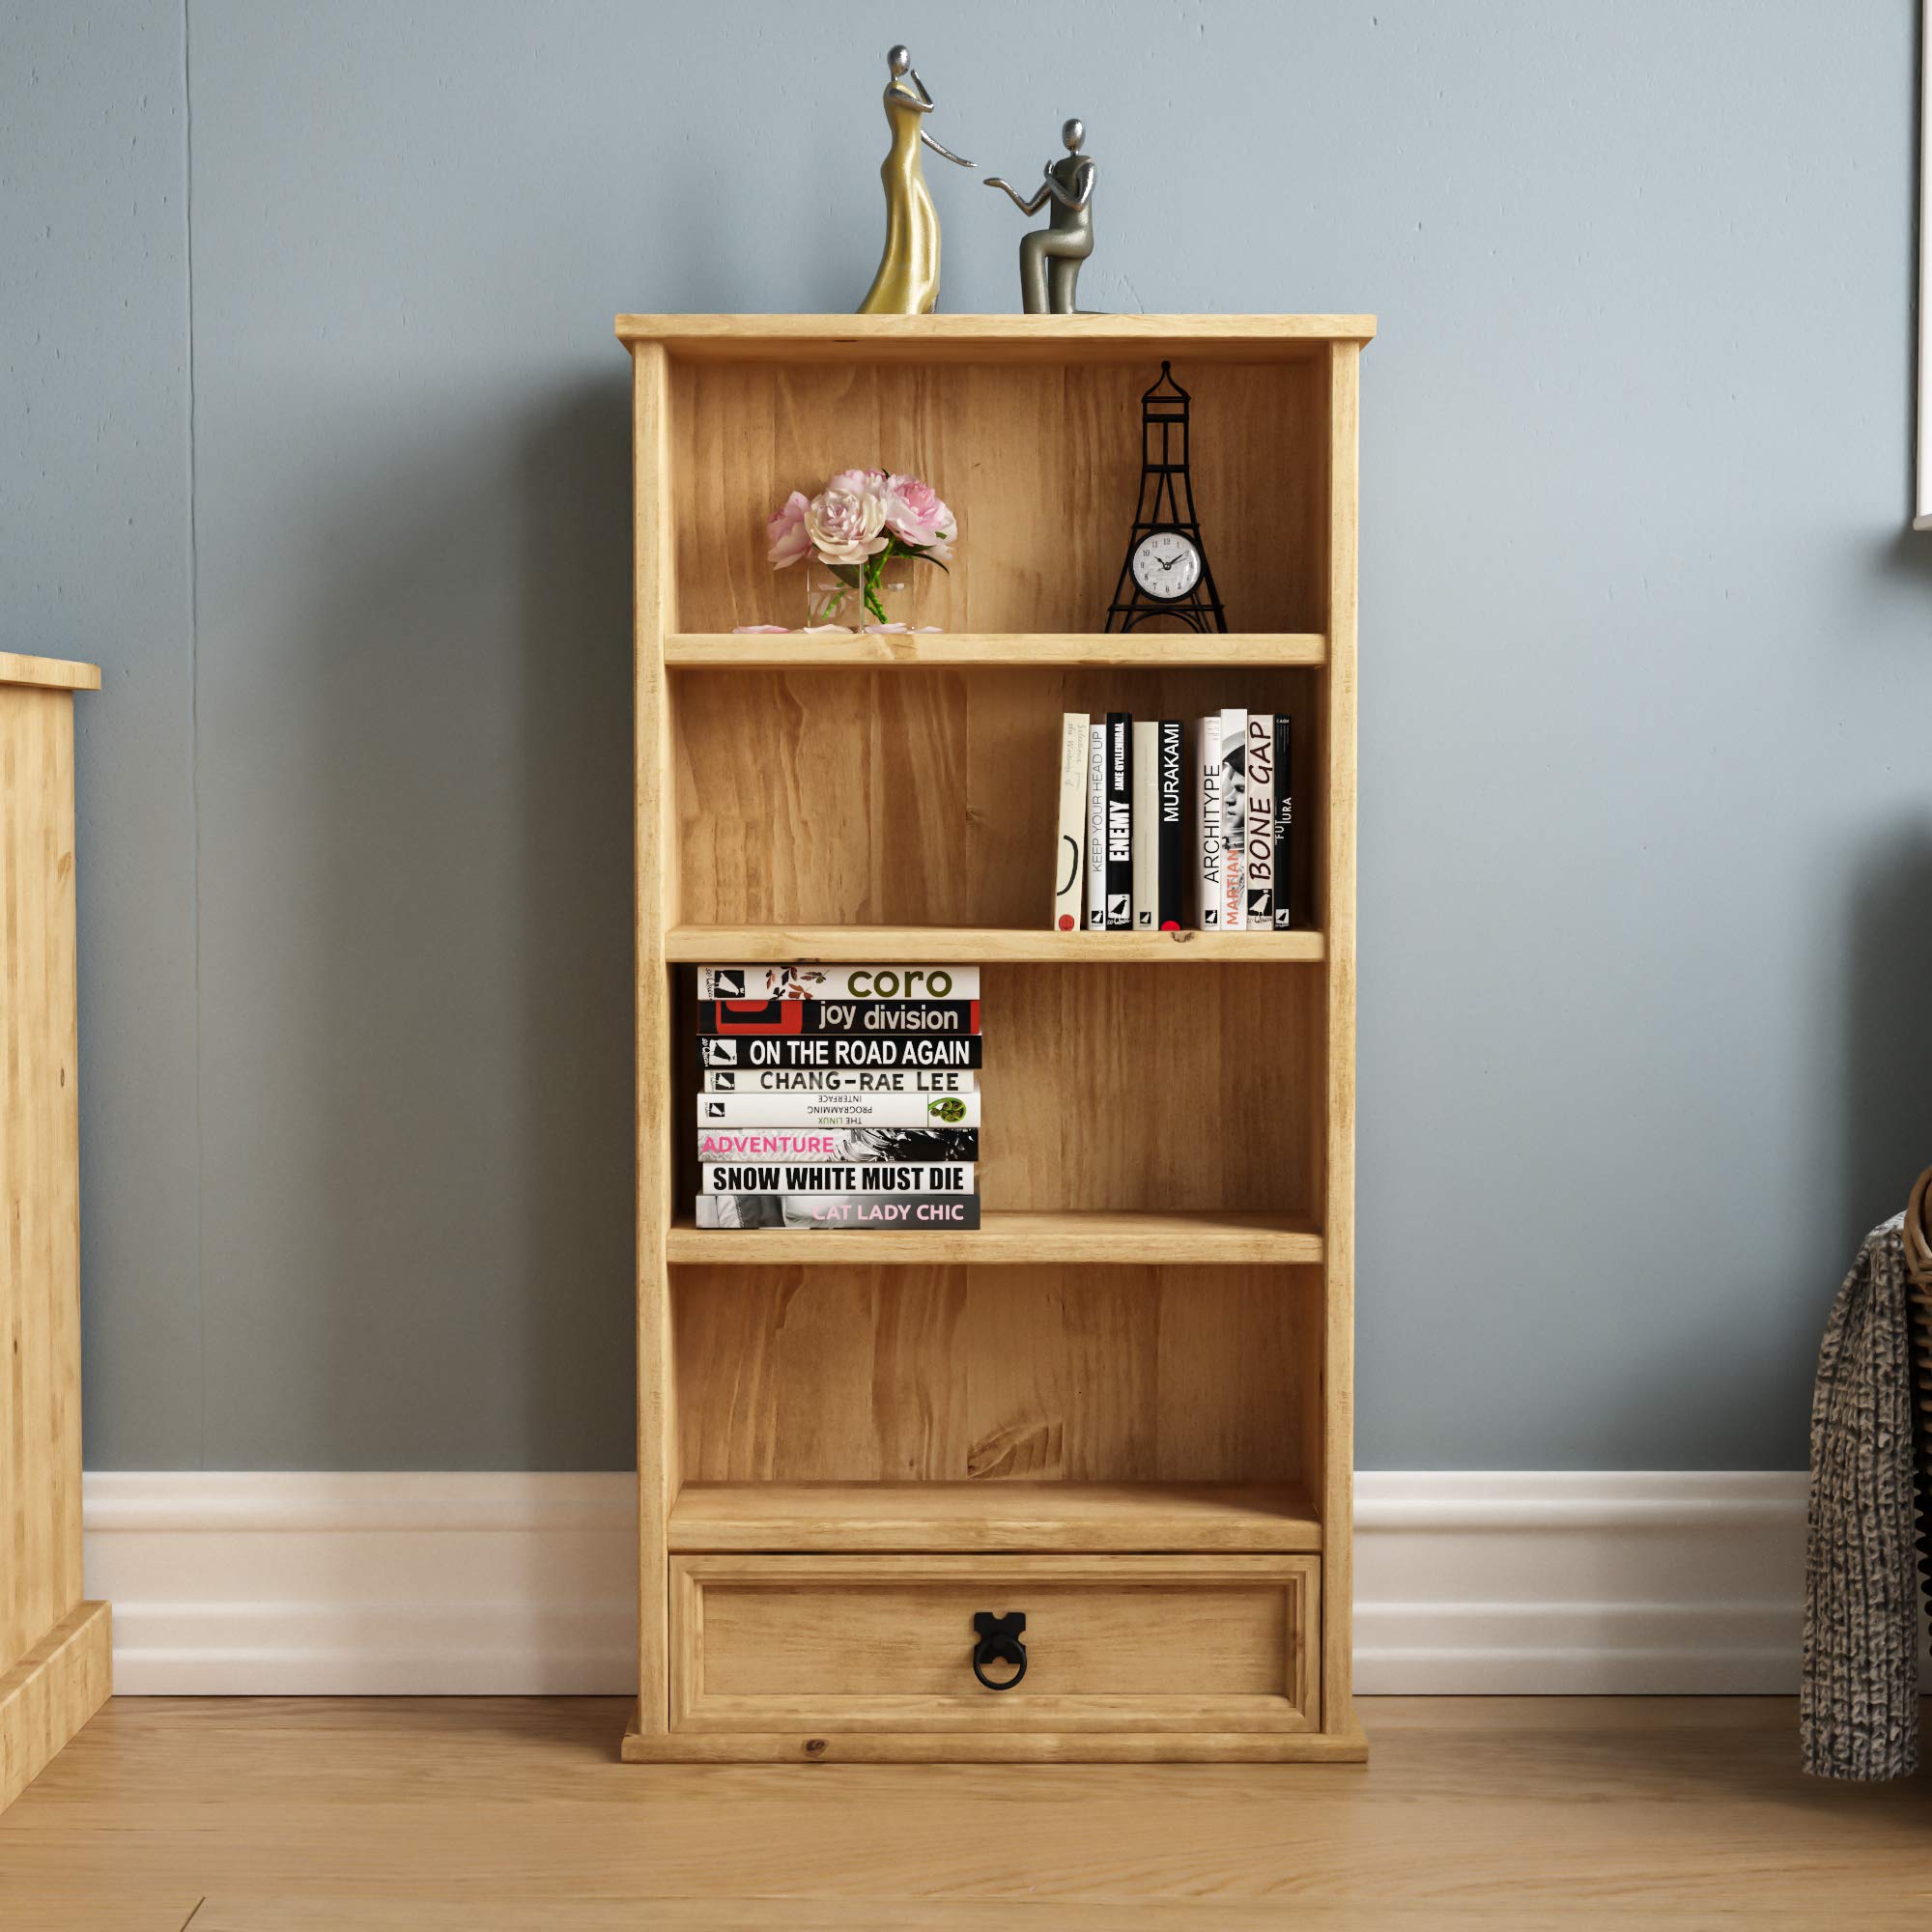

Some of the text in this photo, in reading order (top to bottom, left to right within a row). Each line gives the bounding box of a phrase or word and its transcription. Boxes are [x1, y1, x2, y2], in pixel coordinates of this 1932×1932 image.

[1115, 723, 1124, 790] JAKE GYLLENHAAL
[1164, 724, 1179, 821] MURAKAMI
[1093, 731, 1102, 871] KEEP YOUR HEAD UP
[1248, 721, 1273, 880] BONE GAP
[1109, 801, 1129, 861] ENEMY
[1204, 764, 1219, 883] ARCHITYPE
[1275, 797, 1292, 838] FUTURA
[1227, 850, 1238, 924] MARTIAN
[847, 971, 952, 997] coro
[819, 1001, 958, 1030] joy division
[750, 1040, 970, 1065] ON THE ROAD AGAIN
[760, 1071, 959, 1091] CHANG-RAE LEE
[808, 1105, 873, 1114] PROGRAMMING
[818, 1094, 863, 1103] INTERFACE
[702, 1137, 834, 1153] ADVENTURE
[713, 1167, 964, 1190] SNOW WHITE MUST DIE
[812, 1205, 964, 1221] CAT LADY CHIC
